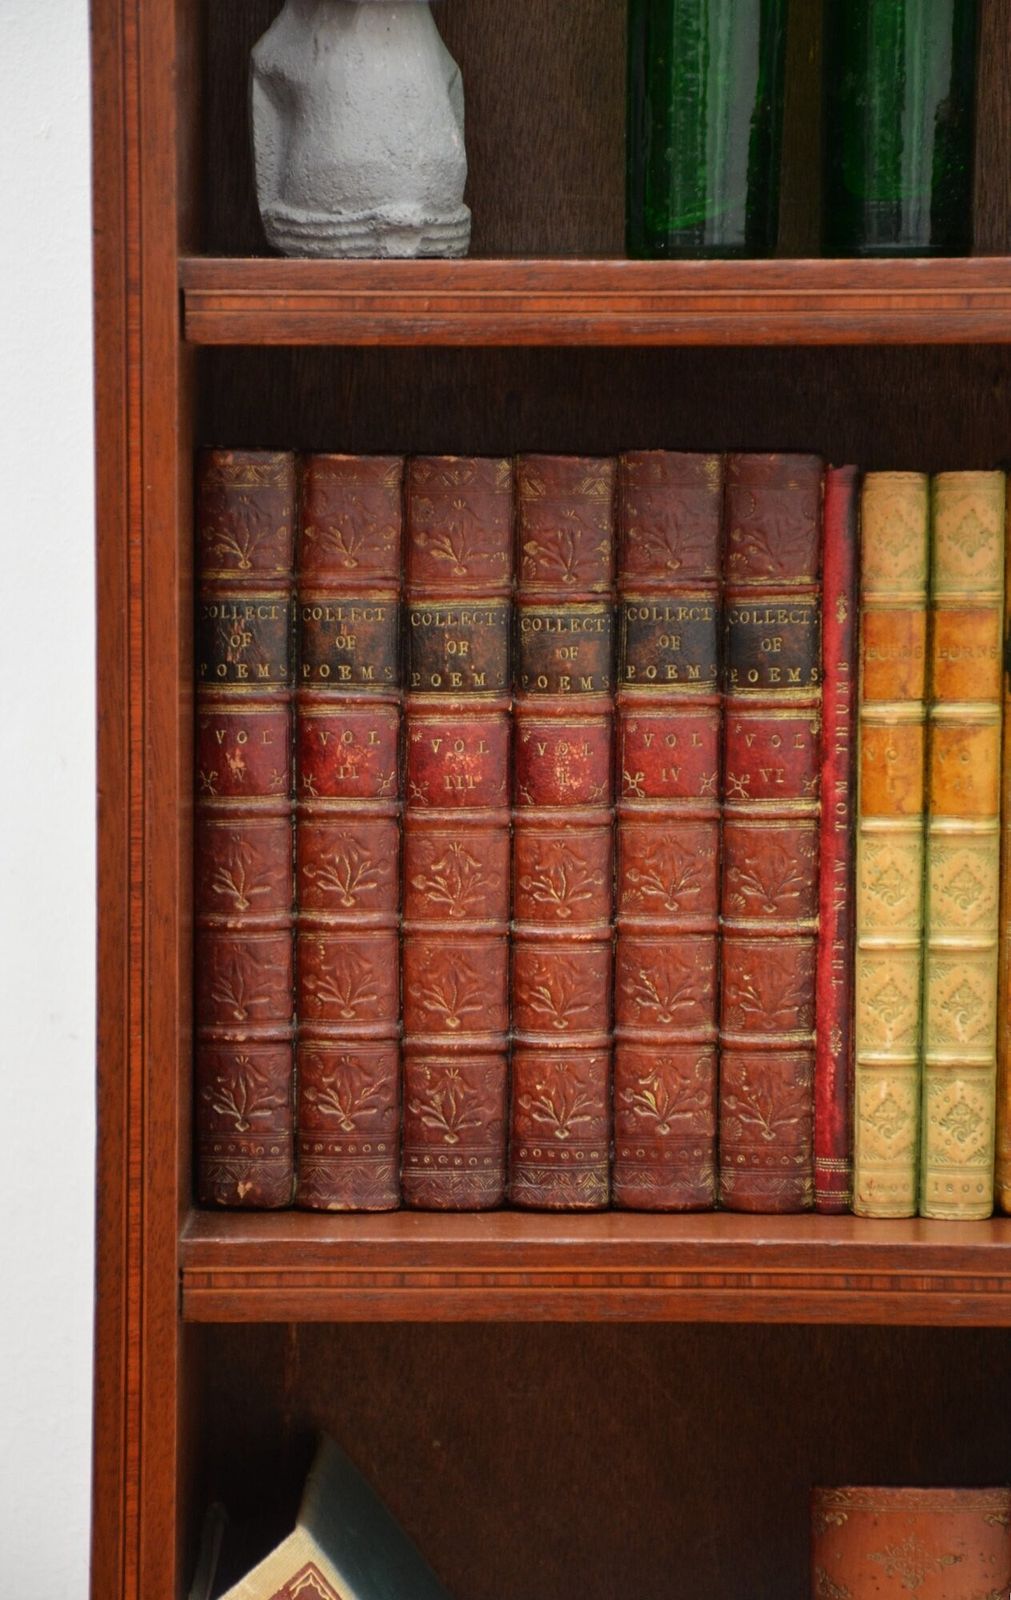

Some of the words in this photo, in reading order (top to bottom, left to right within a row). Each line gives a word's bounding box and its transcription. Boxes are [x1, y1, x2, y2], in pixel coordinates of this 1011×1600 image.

[230, 632, 252, 648] OF
[336, 635, 356, 650] OF
[659, 634, 681, 651] OF
[761, 637, 782, 652] OF
[447, 640, 469, 657] OF
[559, 646, 579, 661] OF
[201, 663, 288, 678] POEMS
[303, 664, 393, 681] POEMS
[626, 664, 717, 679] POEMS
[730, 667, 818, 682] POEMS
[411, 672, 505, 687] POEMS
[521, 675, 609, 691] POEMS
[835, 661, 850, 755] THUMB
[215, 730, 273, 745] VOL
[319, 731, 382, 745] VOL
[644, 733, 703, 747] VOL
[745, 734, 805, 748] VOL
[431, 738, 490, 754] VOL
[537, 742, 594, 757] VOL
[443, 775, 477, 789] III
[661, 768, 682, 782] IV
[759, 768, 785, 783] VI
[834, 780, 848, 832] TOM
[833, 860, 847, 910] NEW
[831, 939, 845, 986] THE
[933, 1182, 985, 1194] 1800
